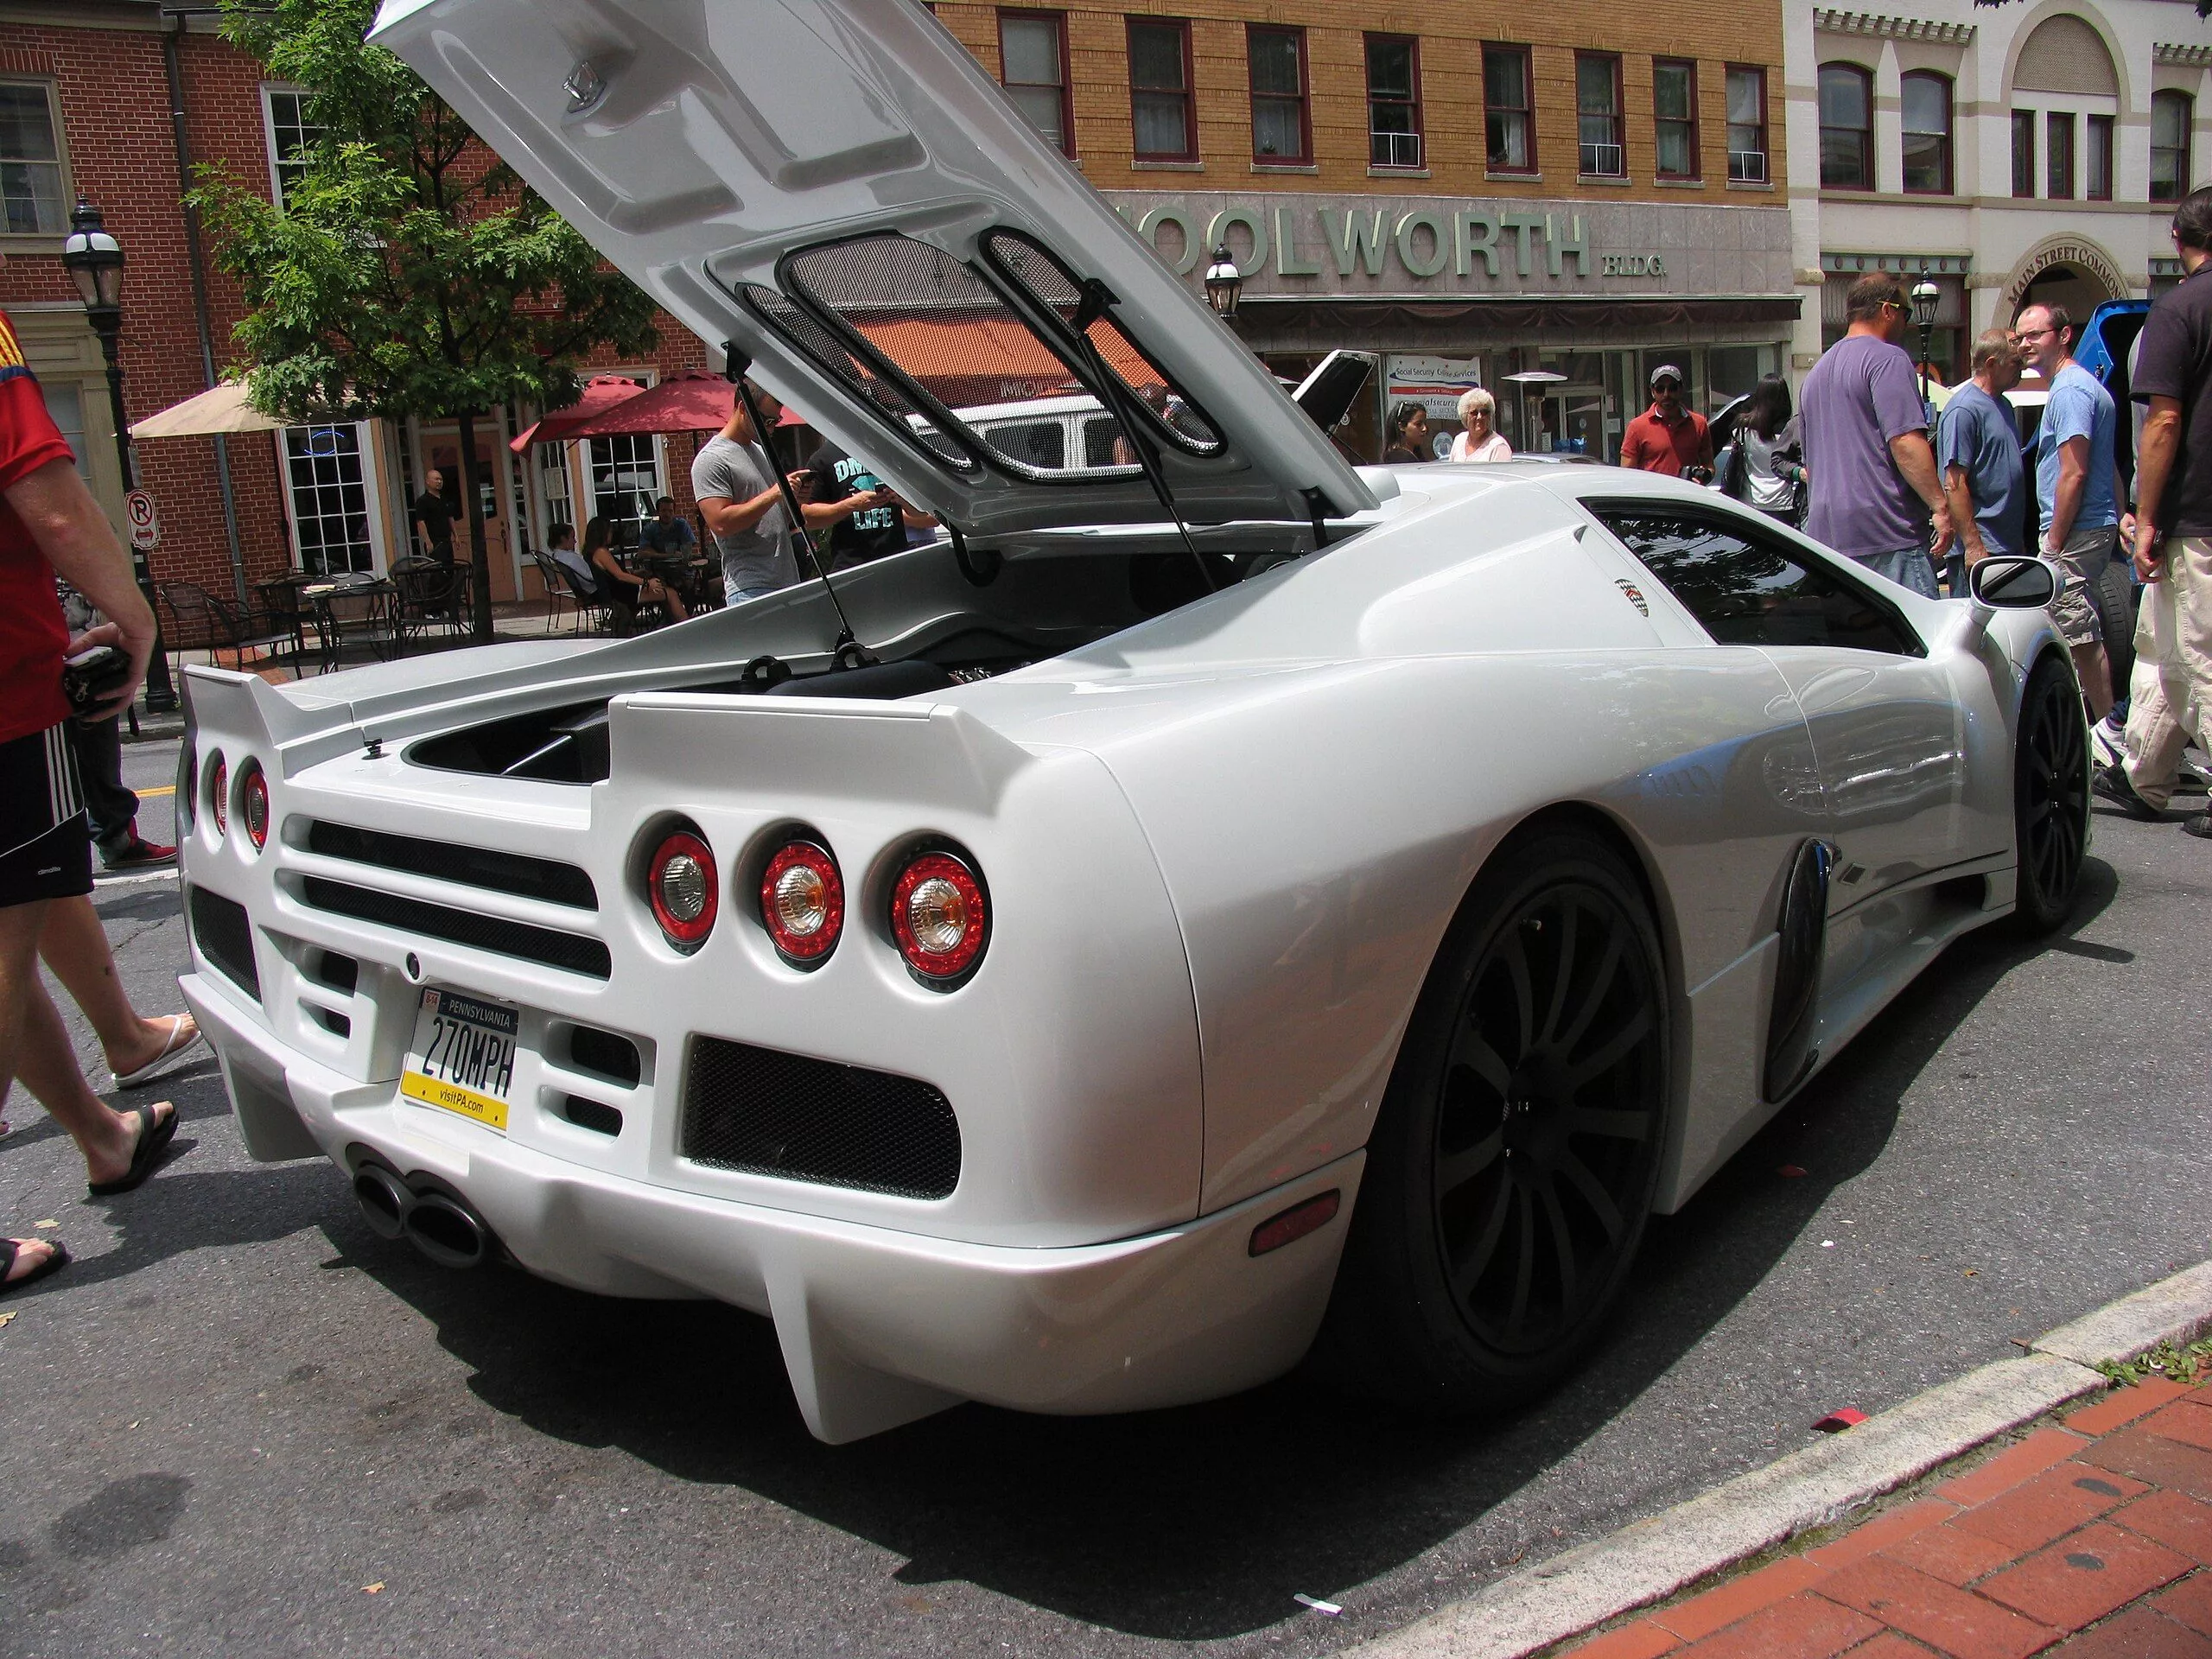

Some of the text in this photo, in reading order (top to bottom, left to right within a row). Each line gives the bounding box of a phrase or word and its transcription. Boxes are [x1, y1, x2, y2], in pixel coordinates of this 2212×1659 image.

[1116, 206, 1590, 276] OOLWORTH
[2006, 246, 2124, 306] MAIN STREET COMMON
[853, 507, 893, 530] LIFE
[449, 999, 510, 1027] PENNSYLVANIA
[422, 1016, 517, 1098] 270MPH
[440, 1090, 484, 1114] visitPA.com
